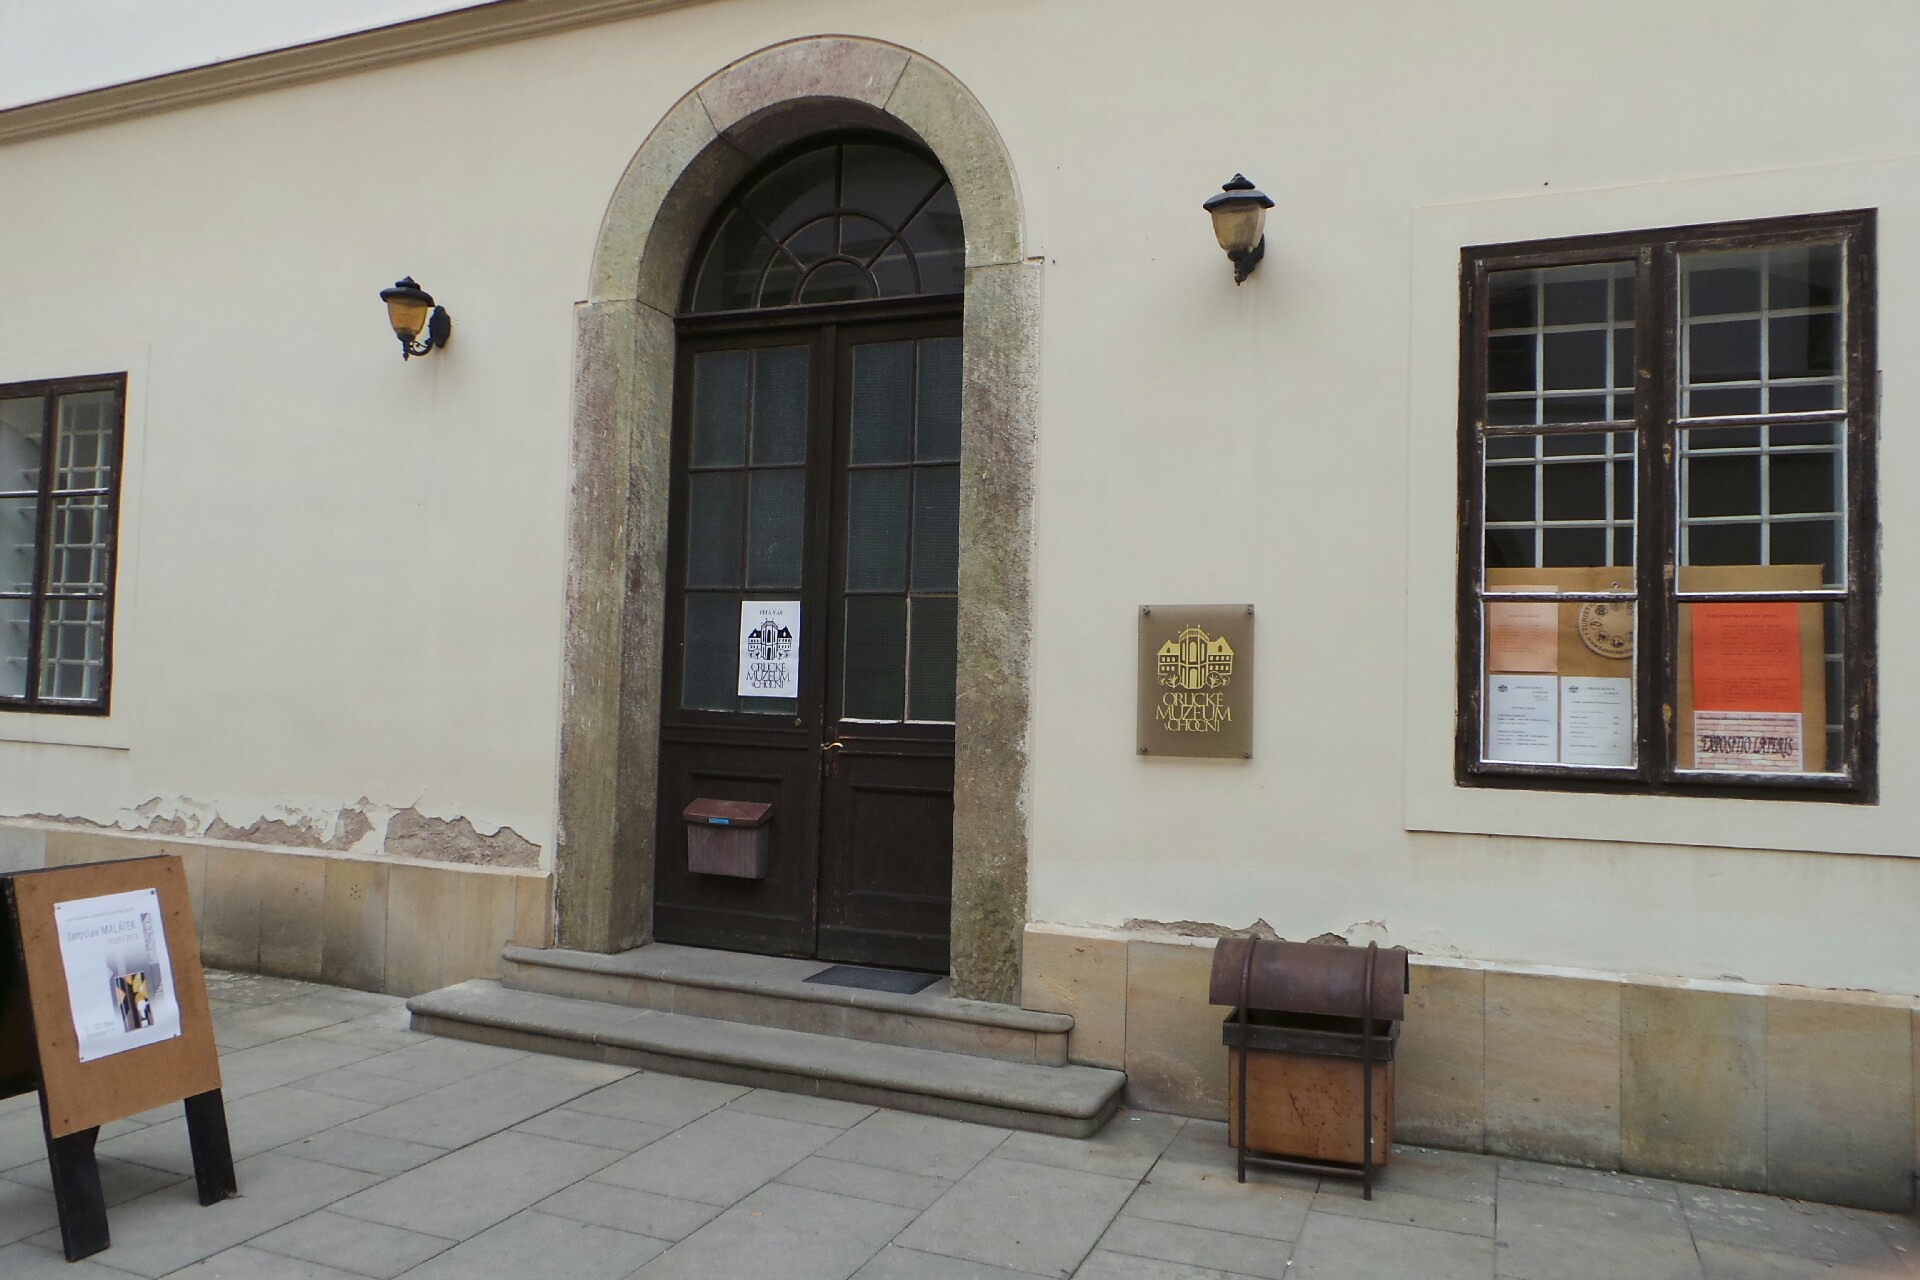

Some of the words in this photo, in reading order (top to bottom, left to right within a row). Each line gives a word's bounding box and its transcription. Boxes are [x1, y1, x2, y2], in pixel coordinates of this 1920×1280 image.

[746, 671, 790, 682] MUZEUM
[1162, 691, 1224, 707] ORLICKÉ
[1155, 705, 1232, 721] MUZEUM
[1168, 719, 1220, 732] CHOCNI
